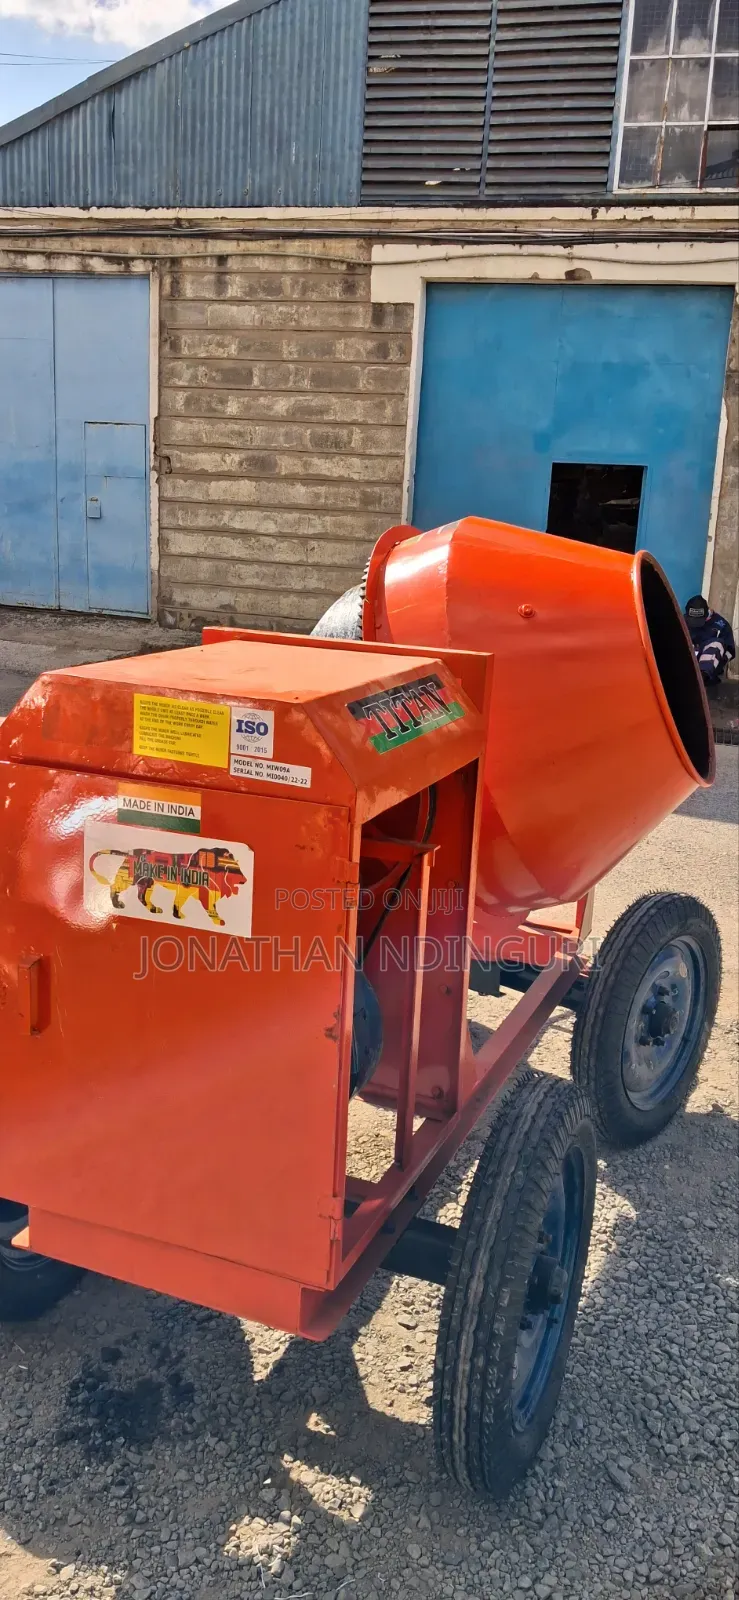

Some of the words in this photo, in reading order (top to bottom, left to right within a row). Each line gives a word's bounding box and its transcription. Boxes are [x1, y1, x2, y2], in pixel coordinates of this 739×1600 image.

[362, 682, 453, 740] TITAN
[236, 720, 268, 736] ISO
[233, 767, 253, 775] SERIAL
[234, 759, 253, 767] MODEL
[266, 764, 290, 773] MIW09A
[122, 798, 151, 810] MADE
[154, 802, 165, 812] IN
[168, 804, 195, 817] INDIA
[133, 860, 164, 879] MAKE
[167, 865, 178, 881] IN
[180, 867, 210, 886] INDIA
